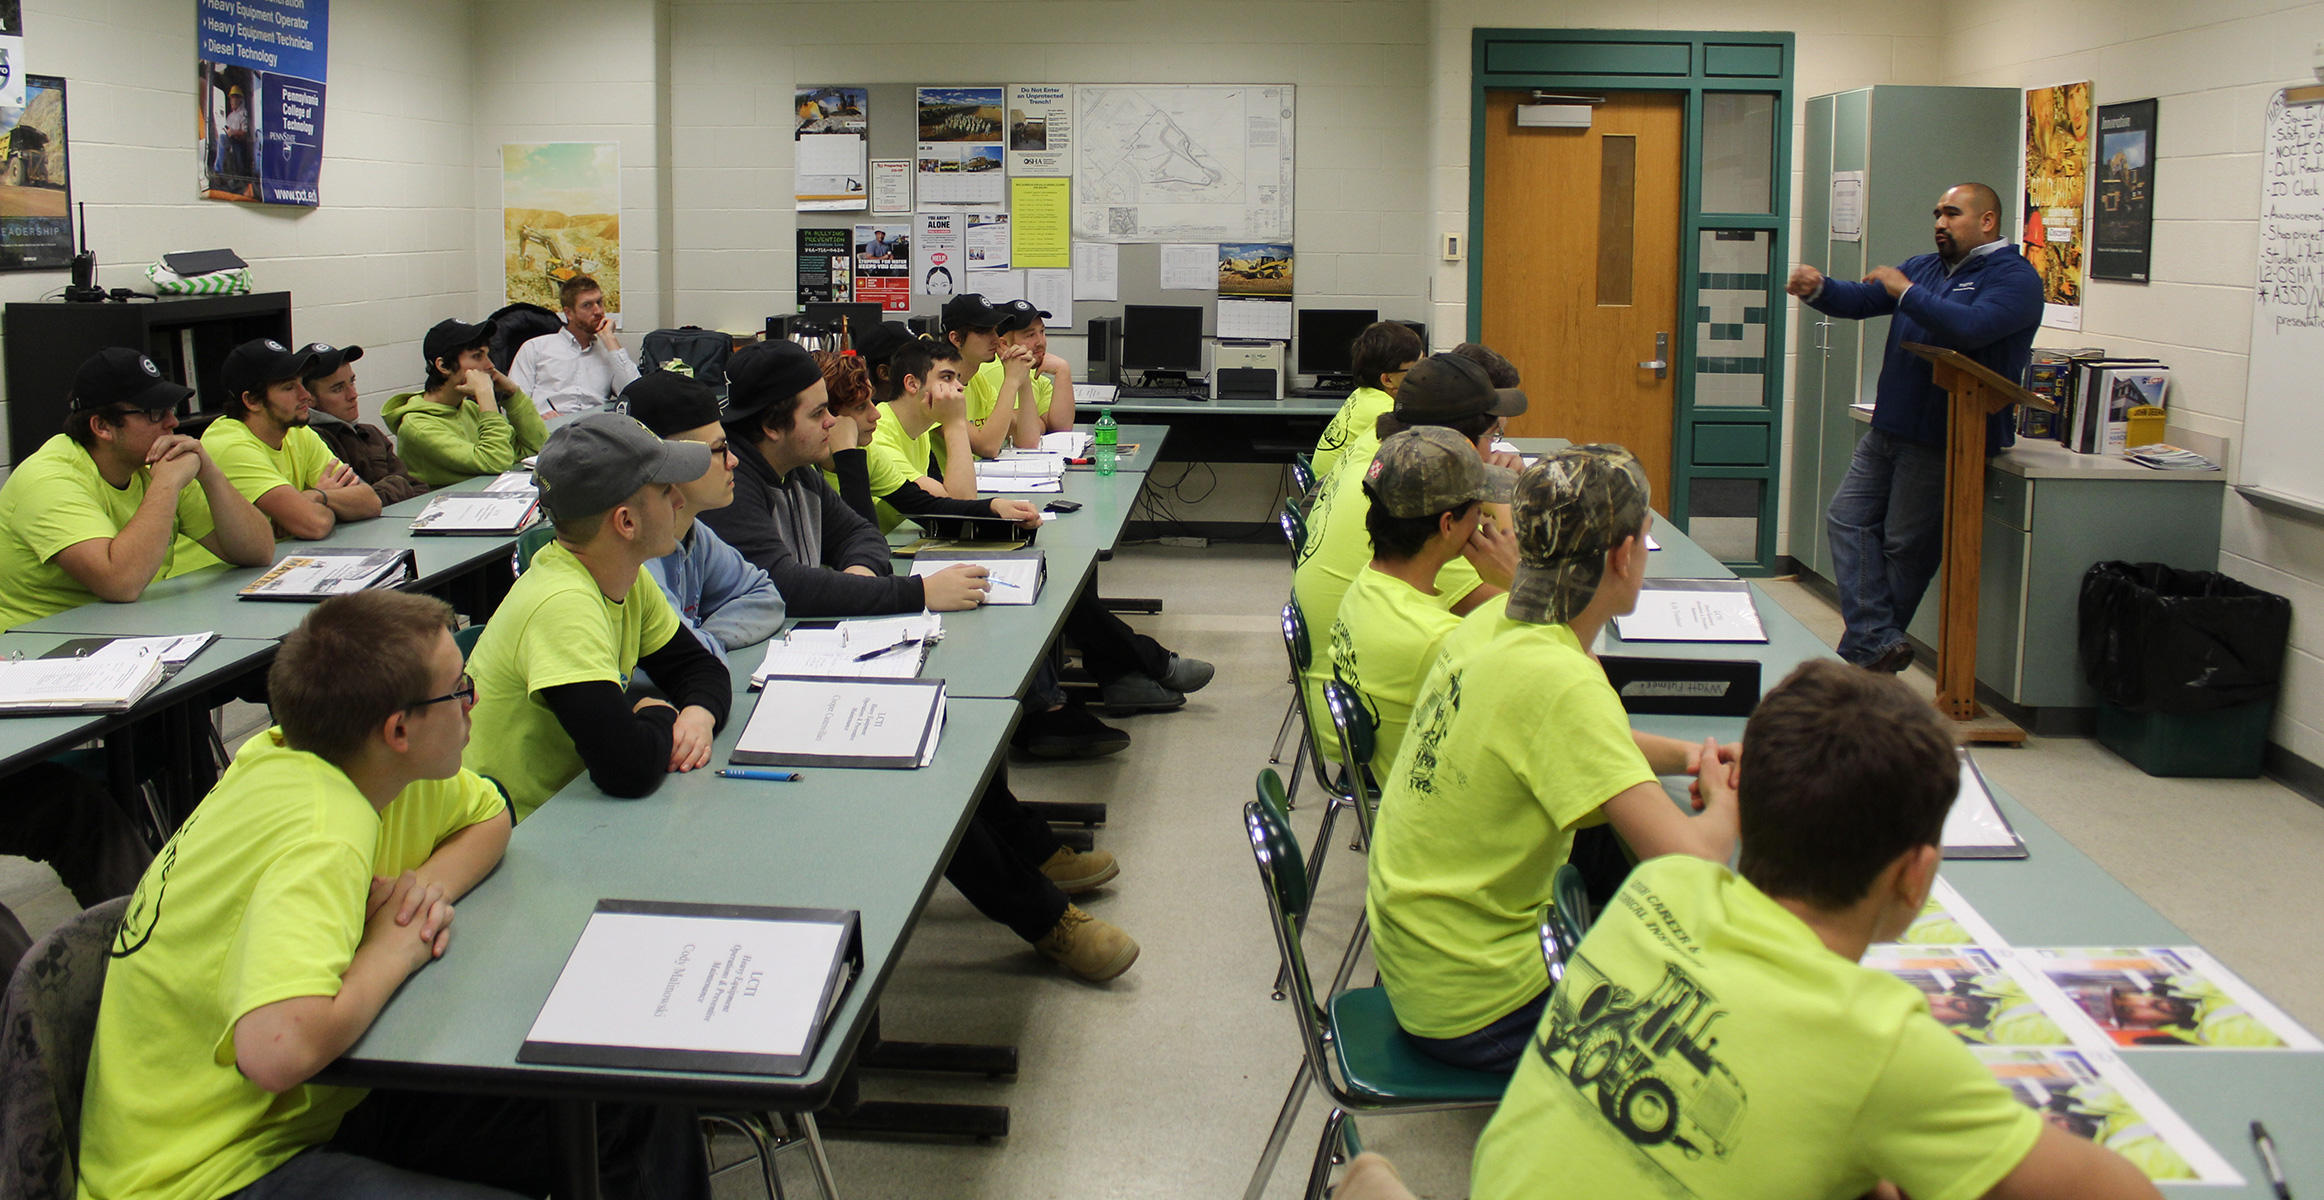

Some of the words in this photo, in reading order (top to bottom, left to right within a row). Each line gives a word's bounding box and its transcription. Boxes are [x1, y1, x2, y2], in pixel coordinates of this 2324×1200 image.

[208, 0, 235, 16] Heavy
[236, 2, 274, 23] Equipment
[275, 12, 309, 30] Operator
[207, 17, 235, 37] Heavy
[237, 23, 275, 43] Equipment
[277, 31, 314, 51] Technician
[208, 38, 235, 56] Diesel
[236, 44, 278, 67] Technology
[282, 88, 319, 107] Pennsylvania
[282, 103, 305, 119] College
[306, 107, 313, 119] of
[283, 117, 314, 136] Technology
[274, 187, 317, 204] www.pct.ed
[1, 226, 60, 237] EADERSHIP
[927, 221, 950, 229] ALONE
[1646, 893, 1690, 946] CAREER
[675, 944, 695, 965] Cody
[736, 954, 752, 976] Heavy
[654, 968, 685, 1017] Malinowski
[722, 977, 743, 1012] Equipment
[744, 972, 763, 997] LCTI
